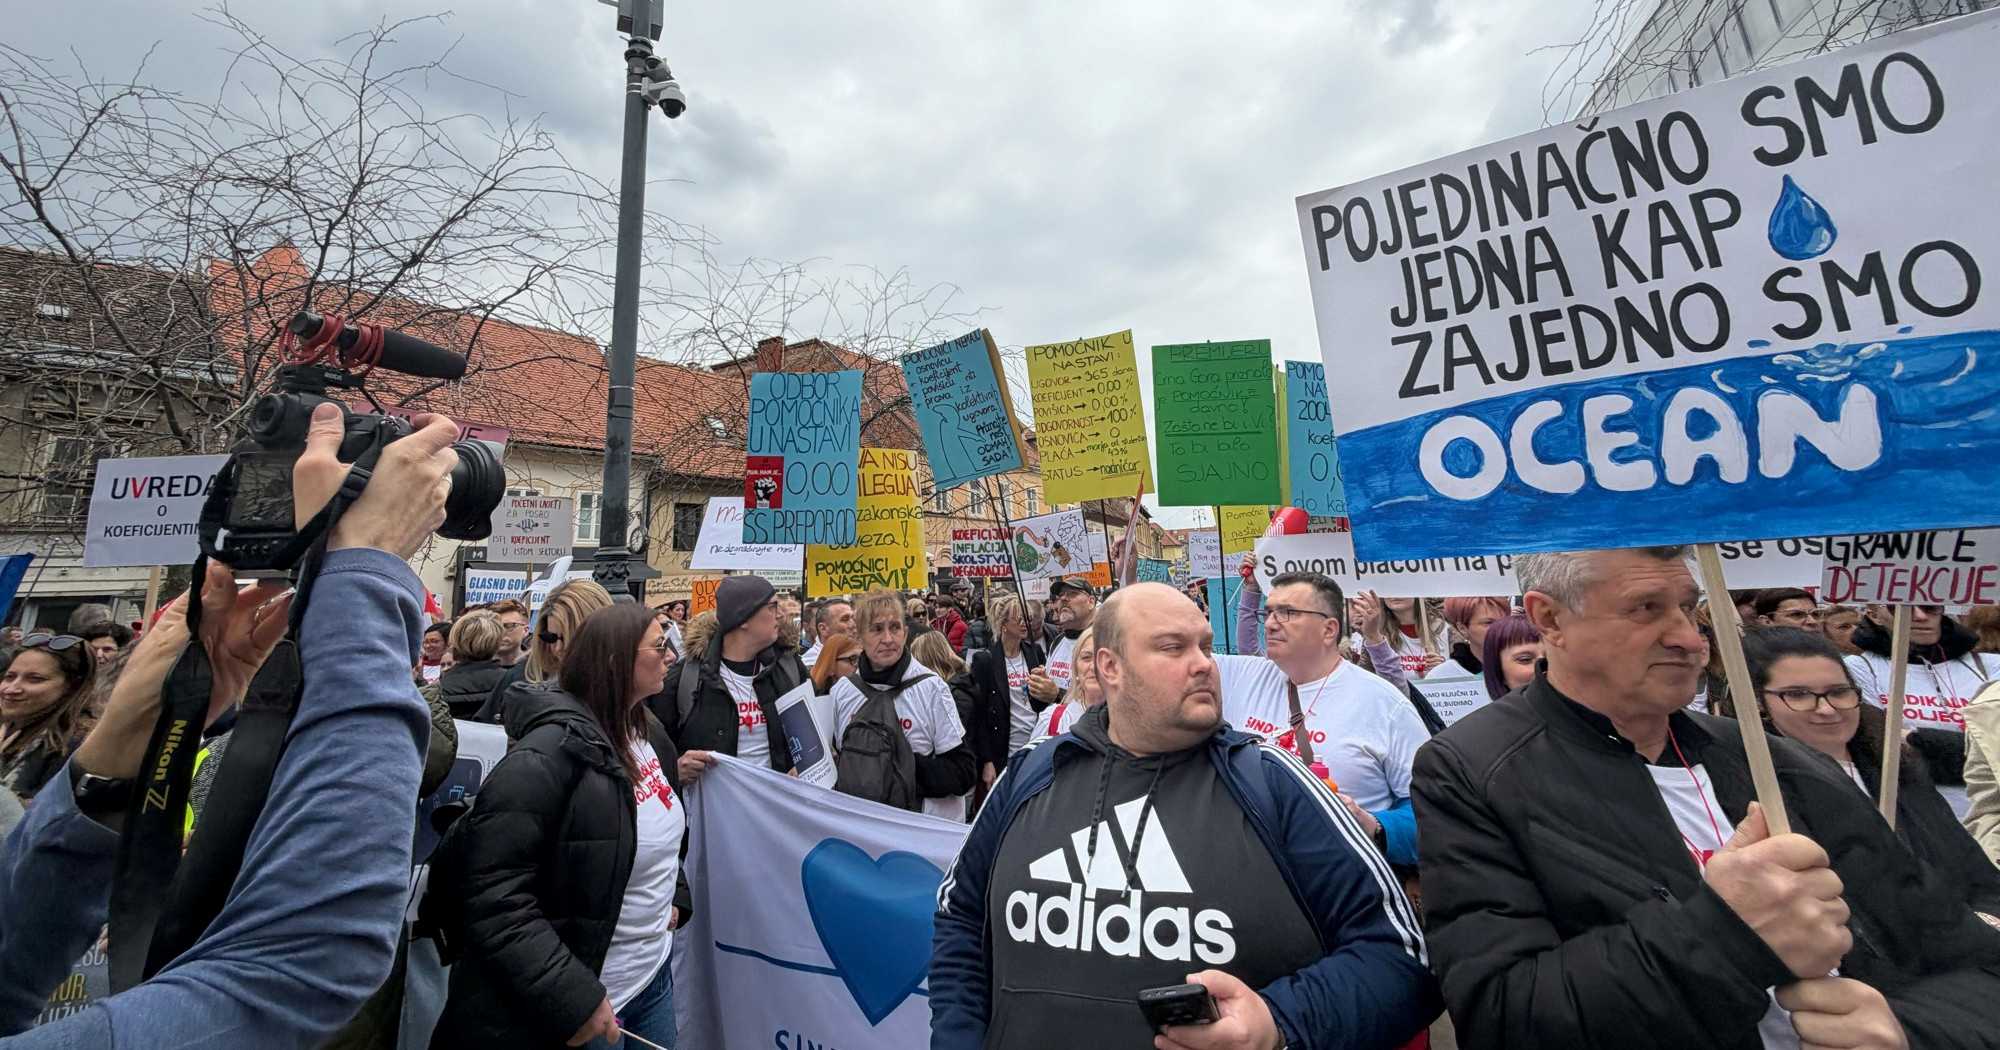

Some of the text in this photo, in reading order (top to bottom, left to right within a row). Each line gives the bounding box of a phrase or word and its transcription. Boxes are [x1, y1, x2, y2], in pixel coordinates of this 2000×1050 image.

[1311, 51, 1944, 271] POJEDINAČNO SMO
[1390, 188, 1741, 327] JEDNA KAP
[1391, 240, 1981, 399] ZAJEDNO SMO
[1122, 332, 1132, 344] U
[1031, 375, 1070, 389] UGOVOR
[1084, 368, 1108, 382] 365
[1190, 367, 1221, 383] Gora
[1286, 362, 1325, 381] POMO
[770, 372, 841, 400] ODBOR
[1304, 381, 1328, 398] NA
[1033, 404, 1074, 418] POVIŠICA
[1036, 415, 1095, 433] ODGOVORNOST
[750, 426, 850, 454] U NASTAVI
[1038, 431, 1088, 447] OSNOVICA
[1170, 441, 1185, 455] To
[1418, 383, 1884, 500] OCEAN
[883, 452, 917, 471] NISU
[1042, 466, 1084, 481] STATUS
[1176, 461, 1269, 482] SJAJNO
[786, 461, 849, 502] 0,00
[858, 472, 922, 499] ILEGIJA!
[157, 505, 167, 516] O
[512, 499, 538, 508] POČETNI
[857, 504, 923, 521] zakonska
[506, 509, 550, 518] ZA POSAO
[774, 509, 857, 545] PREPOROD
[511, 535, 551, 544] KOEFICIJENT
[953, 542, 1010, 553] INFLACIJA
[502, 548, 566, 556] U ISTOM SEKTORU
[1263, 555, 1278, 577] S
[1777, 538, 1823, 556] os
[815, 554, 888, 576] POMOĆNICI
[952, 565, 1012, 577] DEGRADACIJA
[469, 577, 526, 590] GLASNO GOV
[1822, 563, 1998, 604] DETEKCIJE
[532, 593, 547, 602] GLA
[697, 596, 716, 610] PR
[154, 720, 188, 780] Nikon
[1005, 882, 1236, 964] adidas
